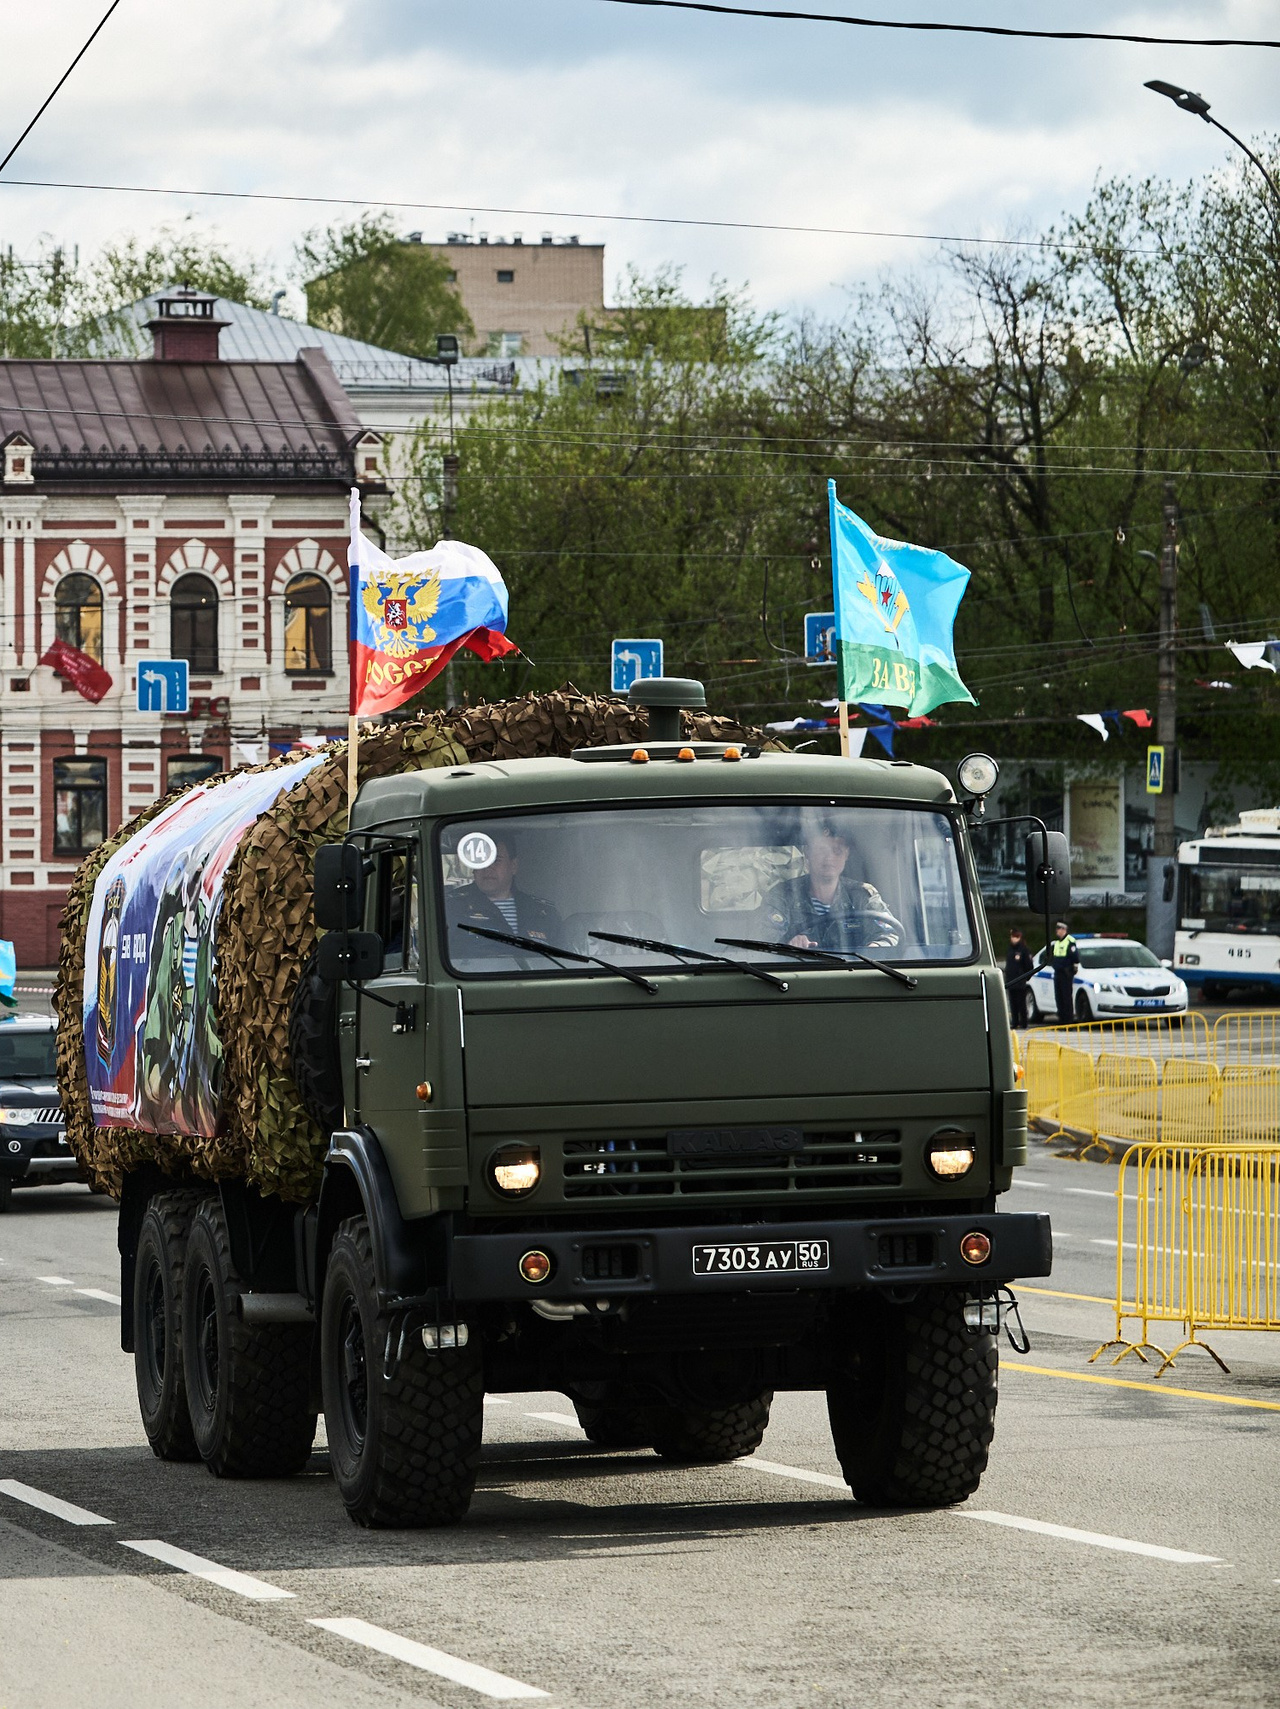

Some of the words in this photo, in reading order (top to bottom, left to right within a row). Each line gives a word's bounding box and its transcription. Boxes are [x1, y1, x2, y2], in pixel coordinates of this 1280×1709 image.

[871, 657, 892, 691] ЗА
[175, 696, 229, 719] FC
[466, 839, 487, 863] 14
[121, 934, 131, 959] 98
[1228, 948, 1252, 958] 485
[672, 1128, 798, 1154] КАМАЗ
[702, 1246, 760, 1271] 7303
[798, 1243, 821, 1261] 50
[801, 1260, 819, 1268] RUS
